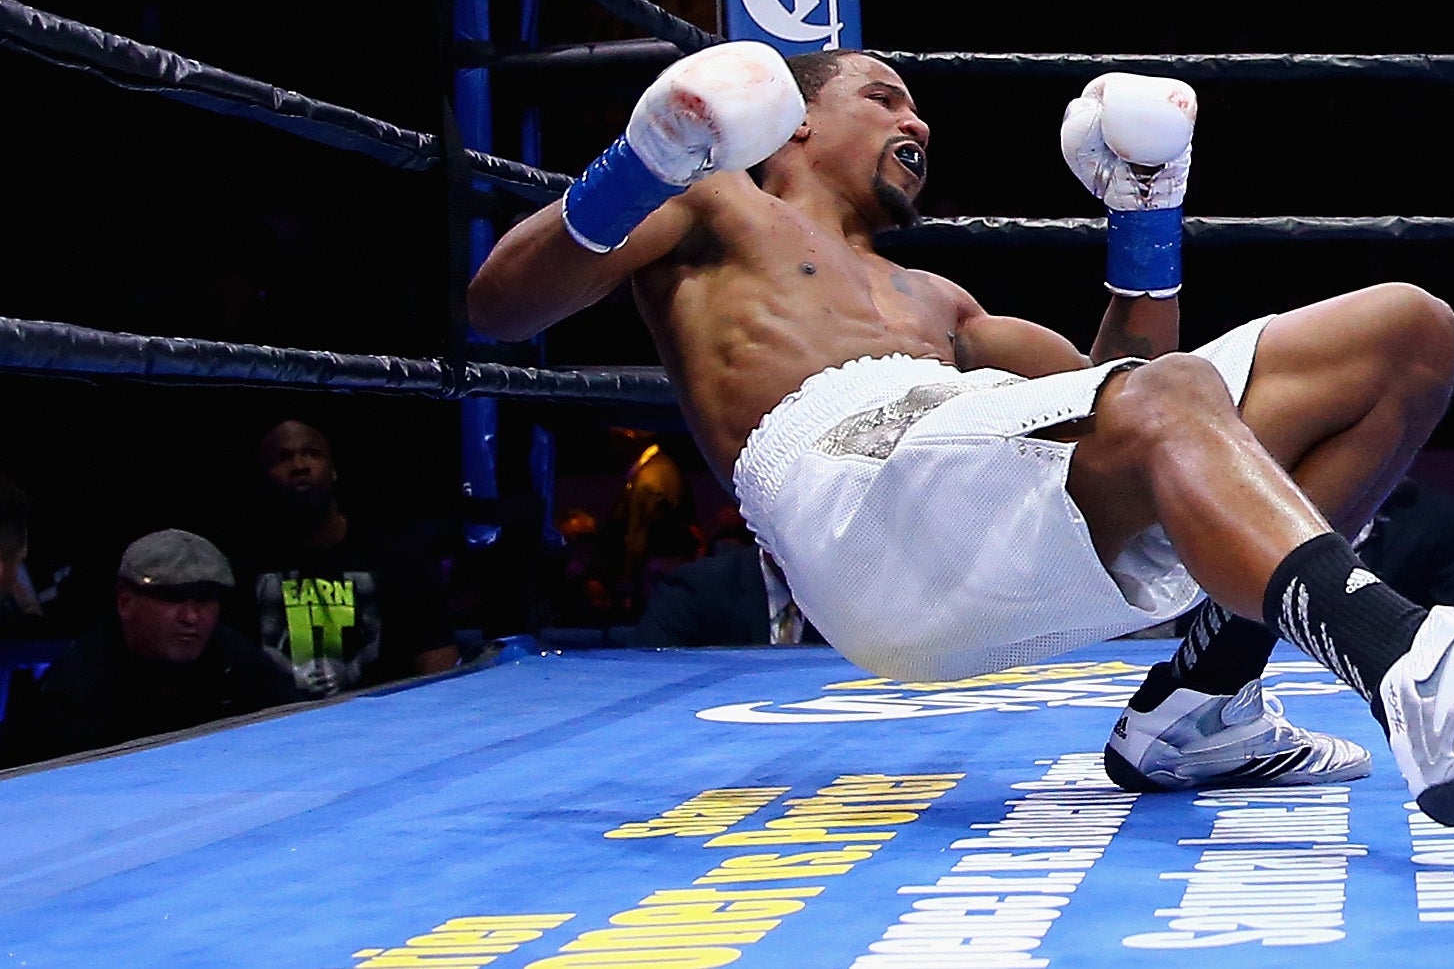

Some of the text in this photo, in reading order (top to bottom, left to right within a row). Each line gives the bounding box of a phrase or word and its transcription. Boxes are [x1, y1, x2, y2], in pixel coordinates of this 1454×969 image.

[281, 578, 354, 606] EARN
[285, 606, 356, 666] IT
[602, 786, 792, 839] Shawn
[702, 773, 967, 849] Porter
[1192, 787, 1352, 807] 20
[949, 790, 1143, 849] Roberto
[1177, 807, 1351, 846] June
[692, 844, 883, 885] vs.
[950, 847, 1106, 872] vs.
[896, 871, 1087, 894] Jr.
[1121, 844, 1369, 949] Saturday,
